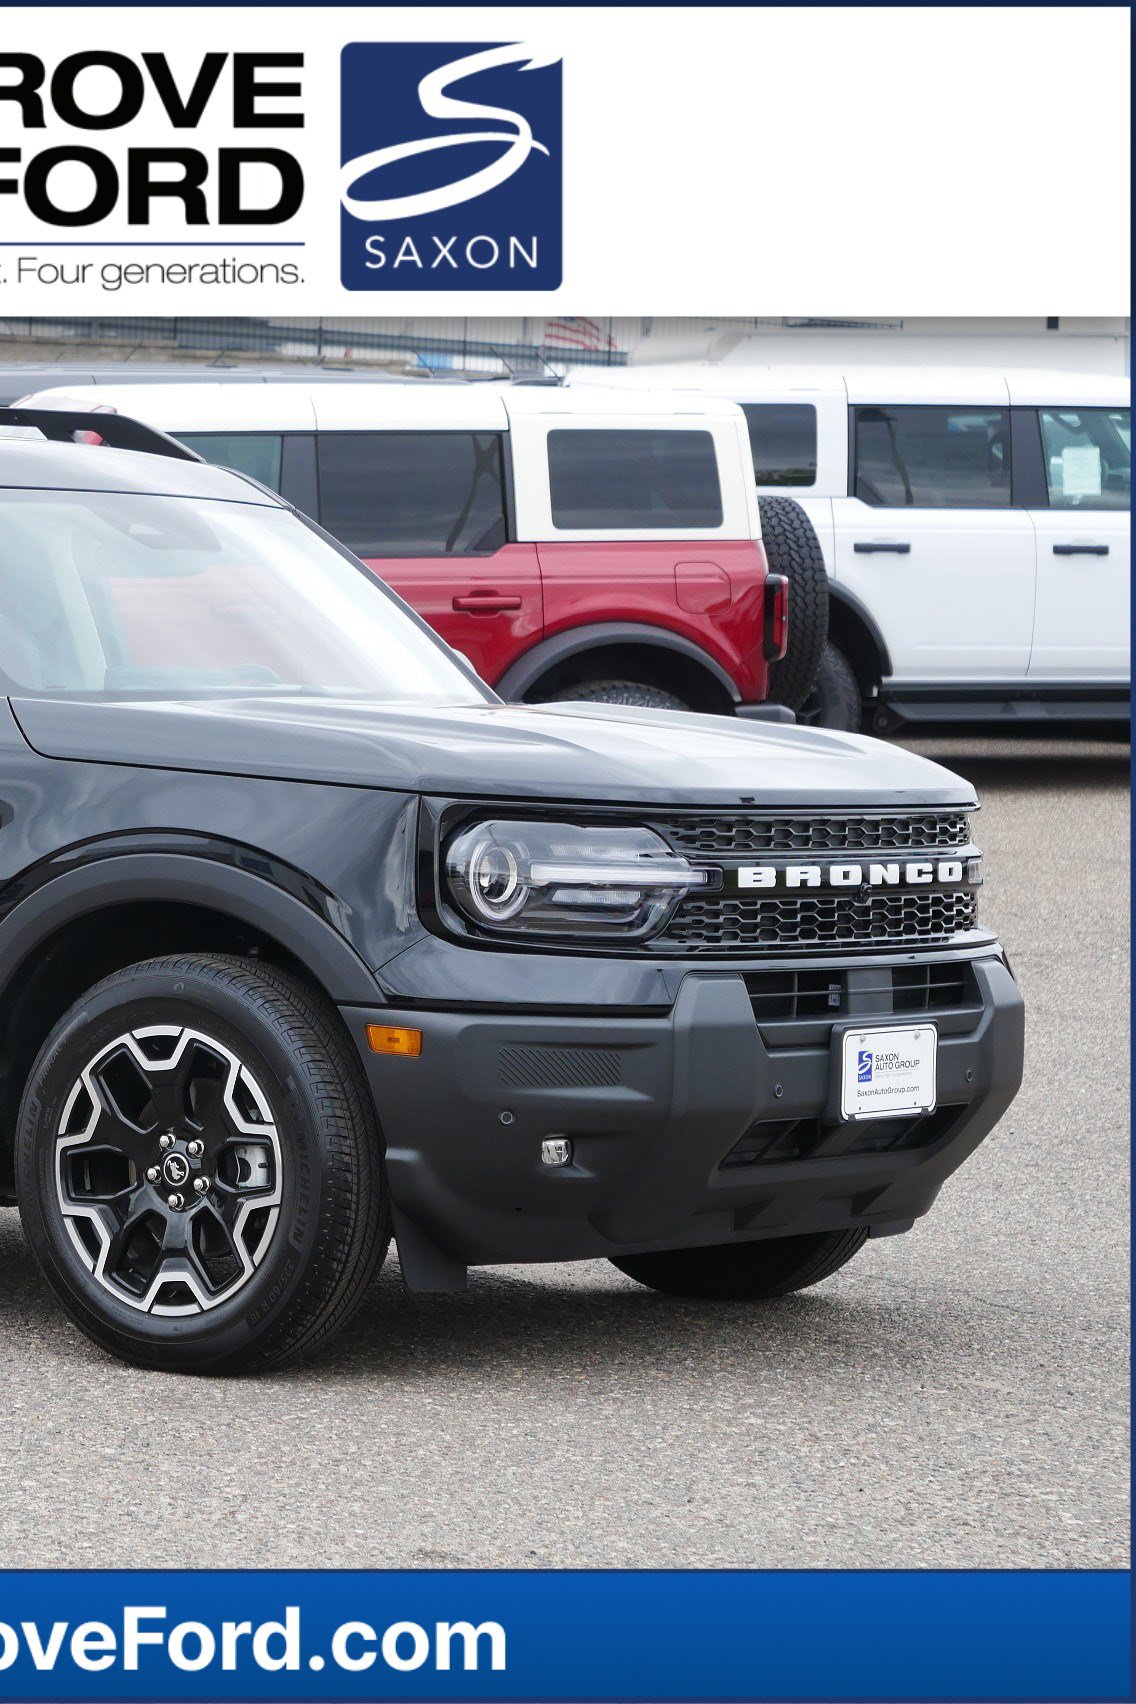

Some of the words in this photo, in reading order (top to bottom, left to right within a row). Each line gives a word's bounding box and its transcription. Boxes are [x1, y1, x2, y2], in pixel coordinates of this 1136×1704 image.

[737, 861, 963, 888] BRONCO
[875, 1053, 900, 1062] SAXON
[875, 1061, 894, 1071] AUTO
[894, 1059, 920, 1070] GROUP
[857, 1086, 920, 1097] SaxonAutoGroup.com
[291, 1131, 311, 1246] MICHELIN
[267, 1257, 295, 1303] 225/60
